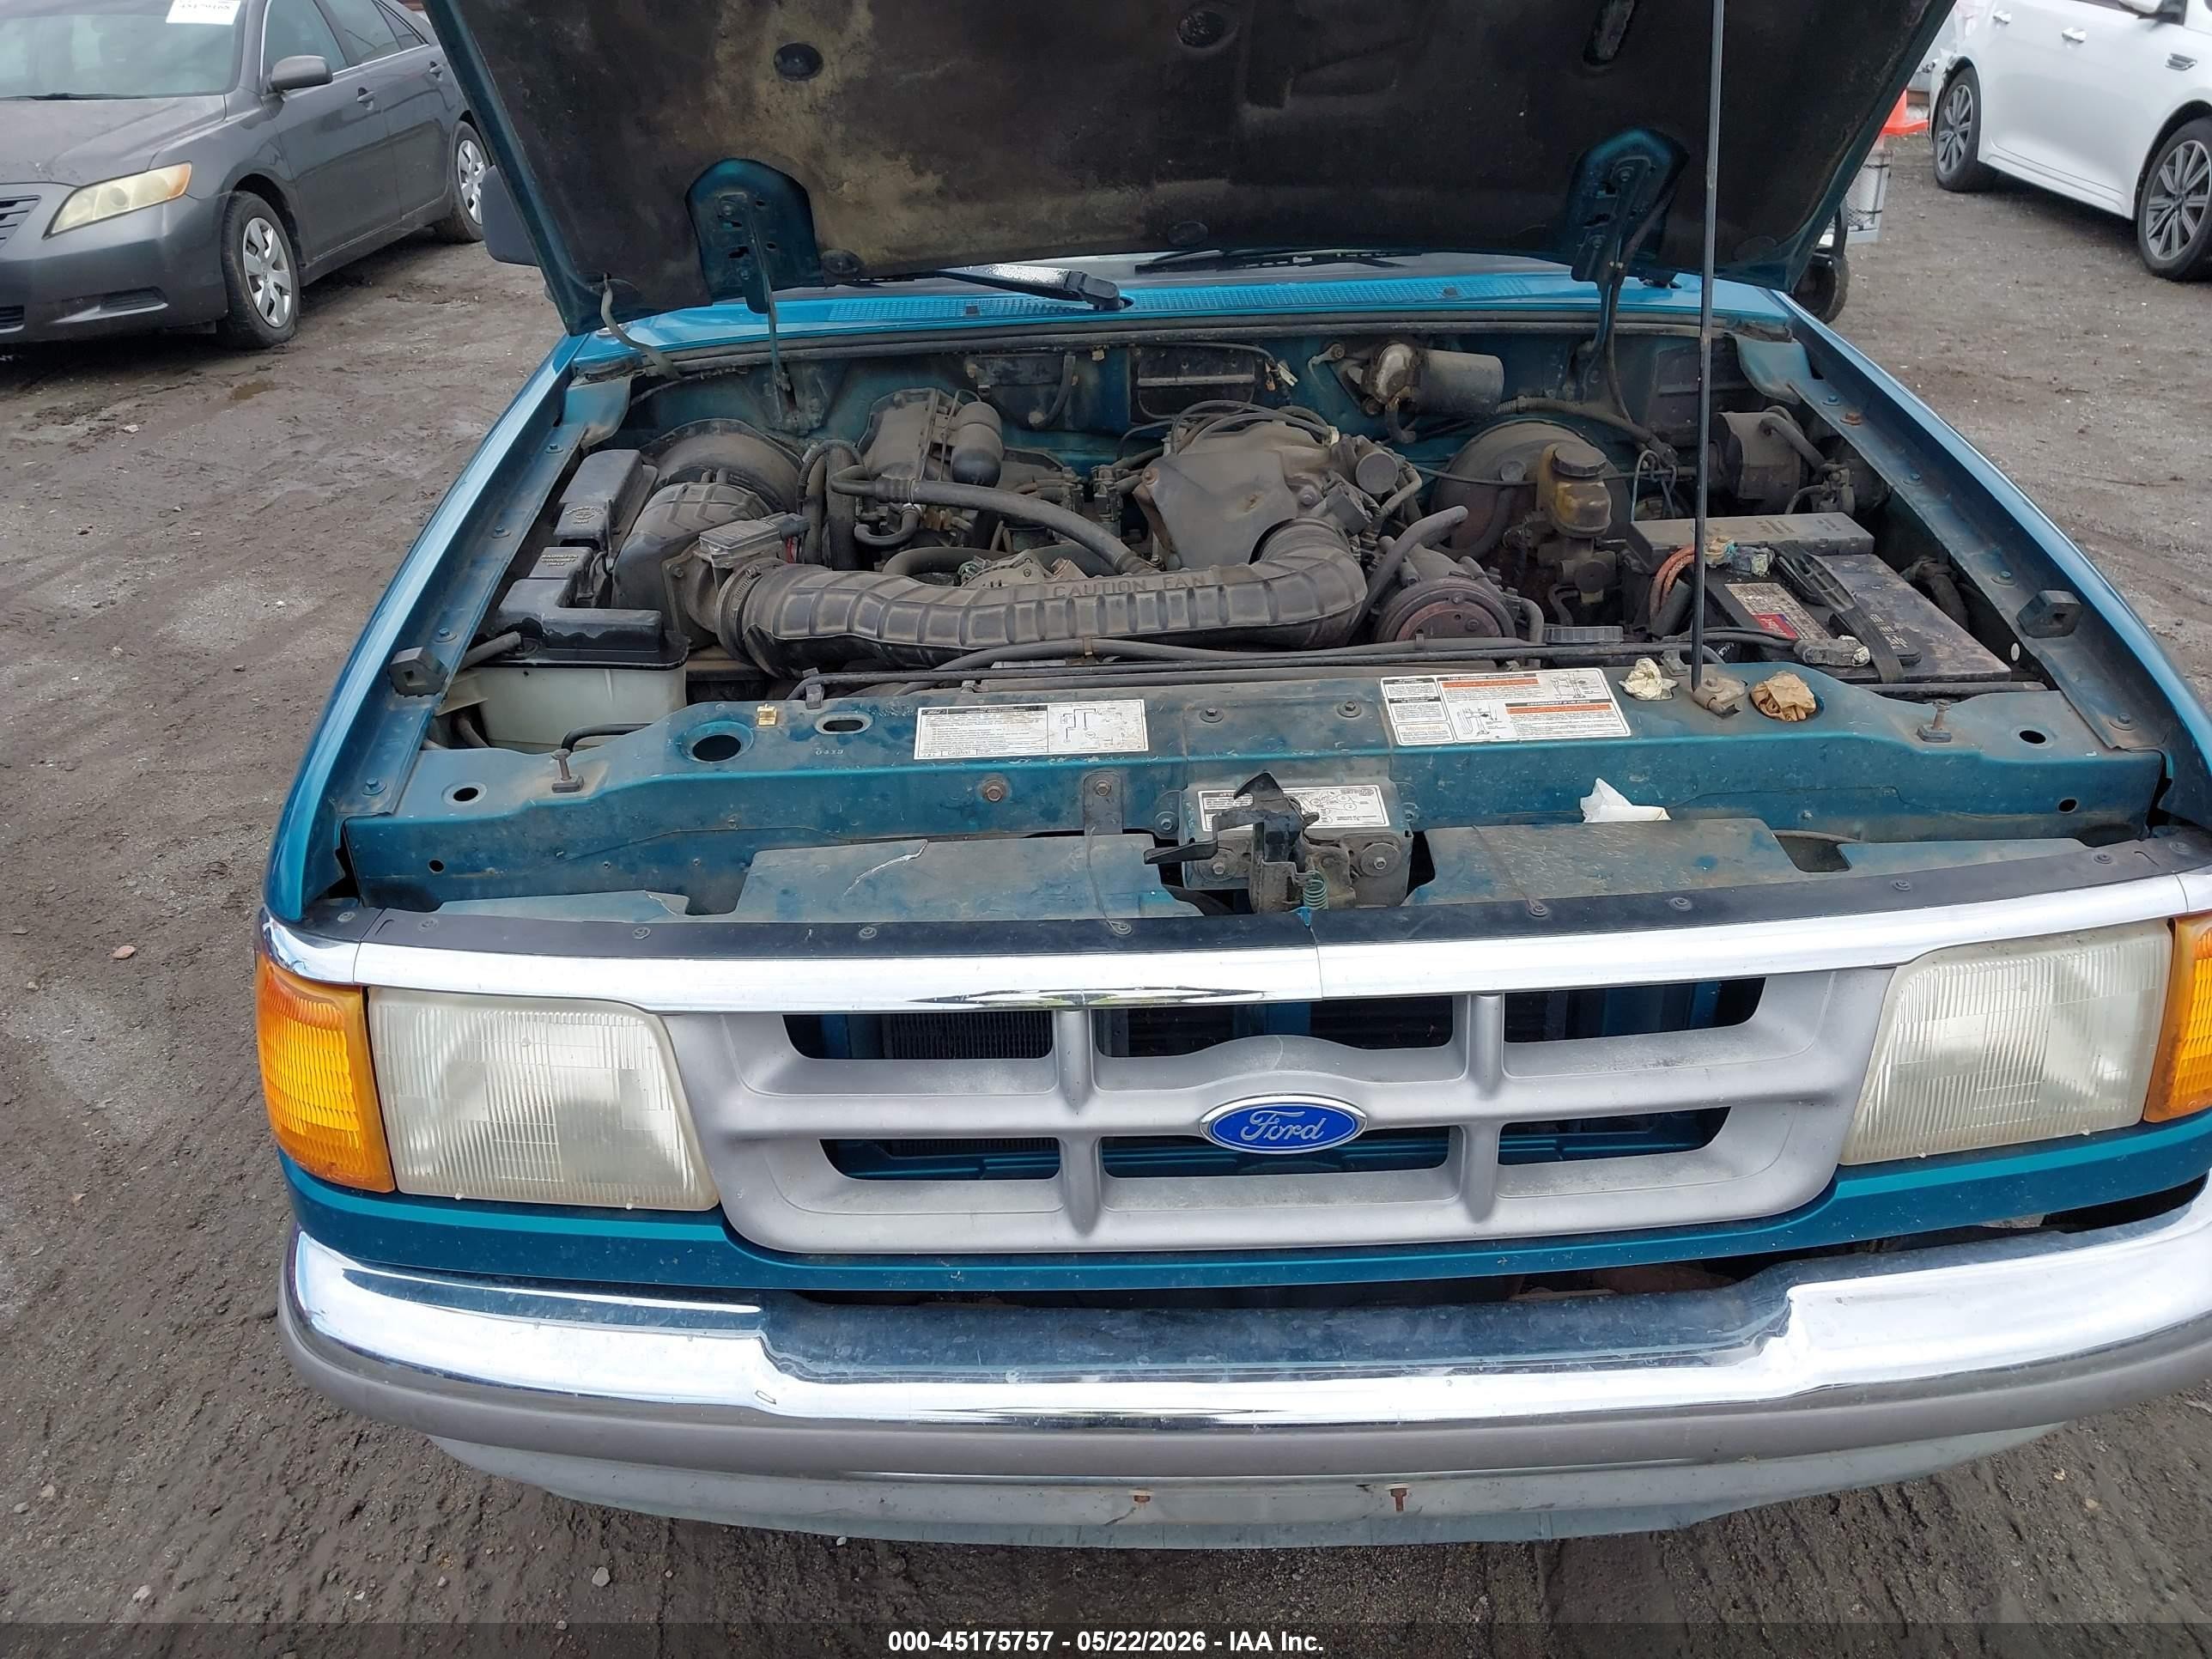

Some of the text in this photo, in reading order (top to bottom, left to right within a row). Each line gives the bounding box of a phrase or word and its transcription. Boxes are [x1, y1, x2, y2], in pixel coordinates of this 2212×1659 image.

[1053, 575, 1206, 598] CAUTION FAN
[1239, 1109, 1328, 1141] Ford
